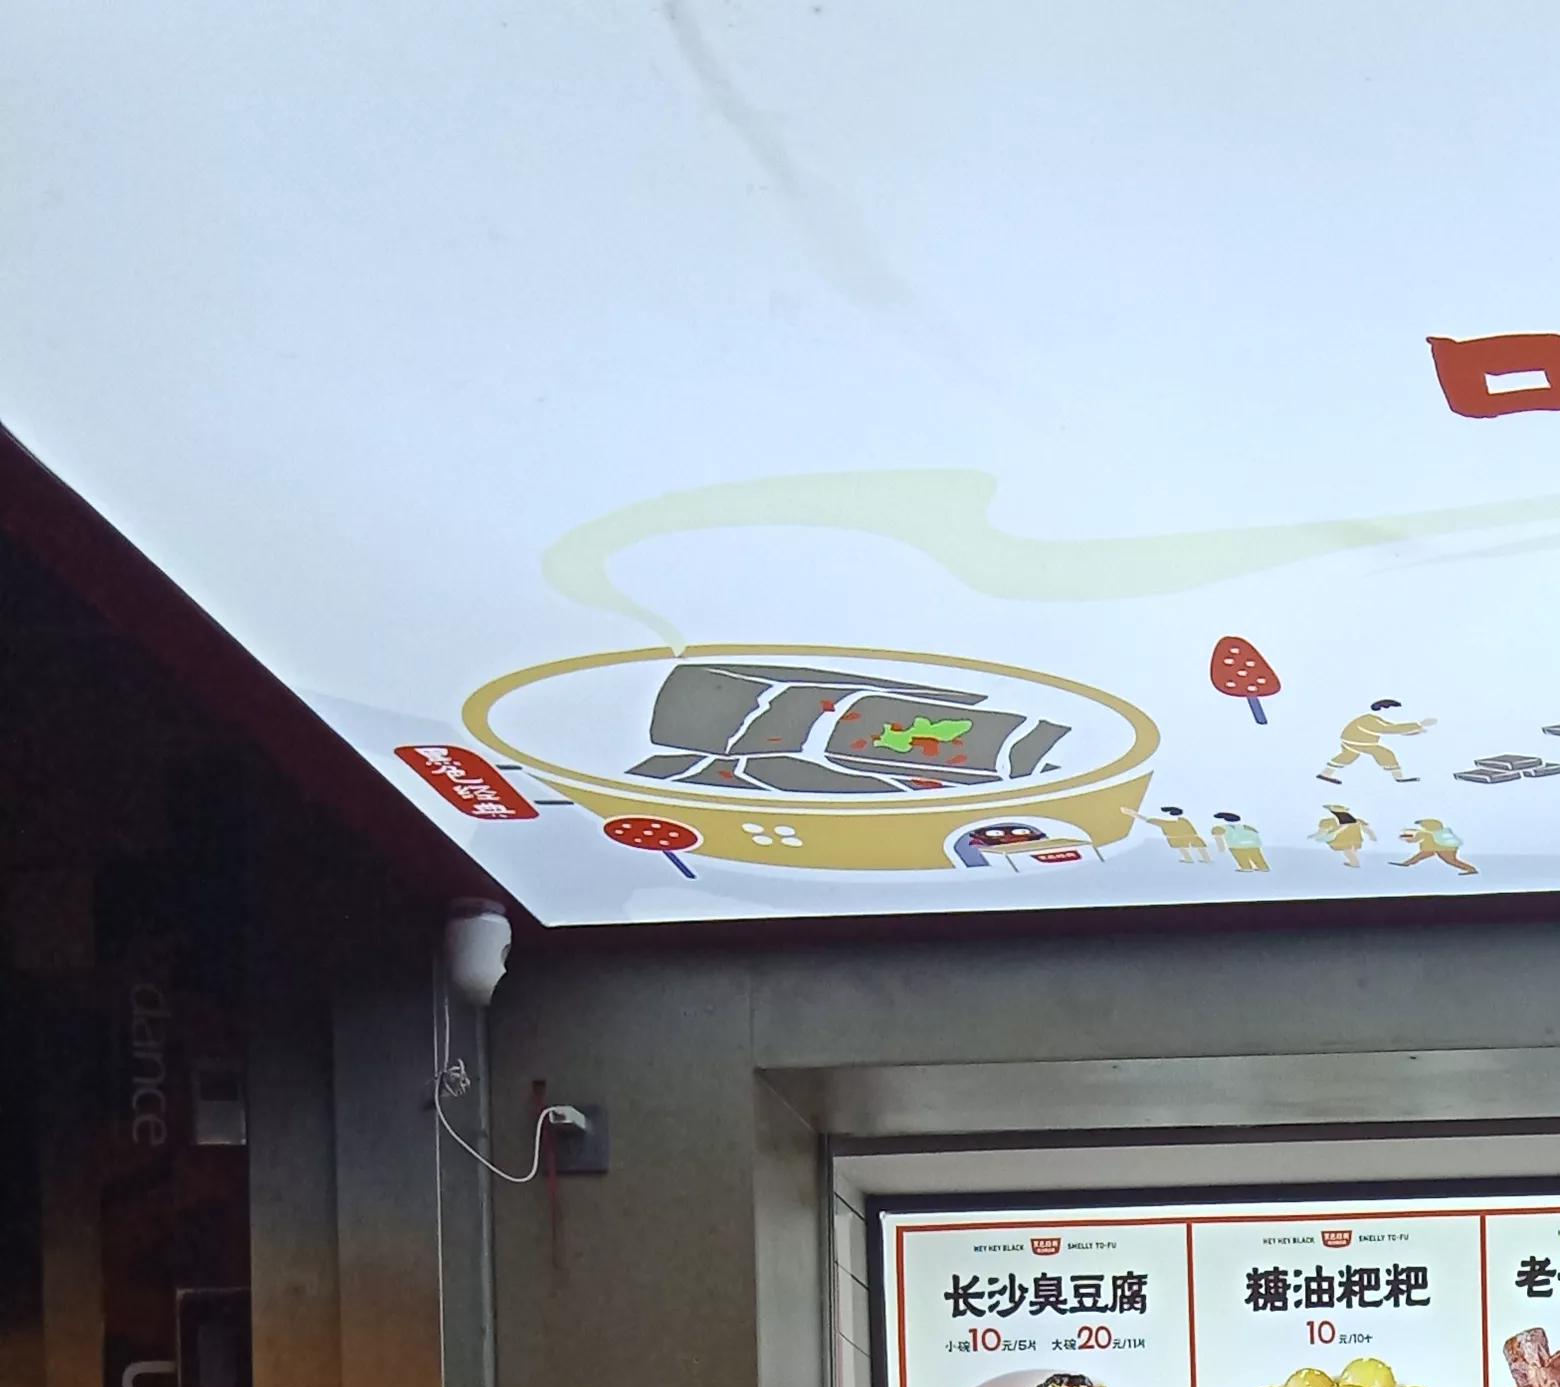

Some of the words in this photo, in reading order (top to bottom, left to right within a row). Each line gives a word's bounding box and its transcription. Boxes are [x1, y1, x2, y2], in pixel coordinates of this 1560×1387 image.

[944, 1271, 1149, 1319] 长沙臭豆腐
[1244, 1263, 1431, 1312] 糖油粑粑
